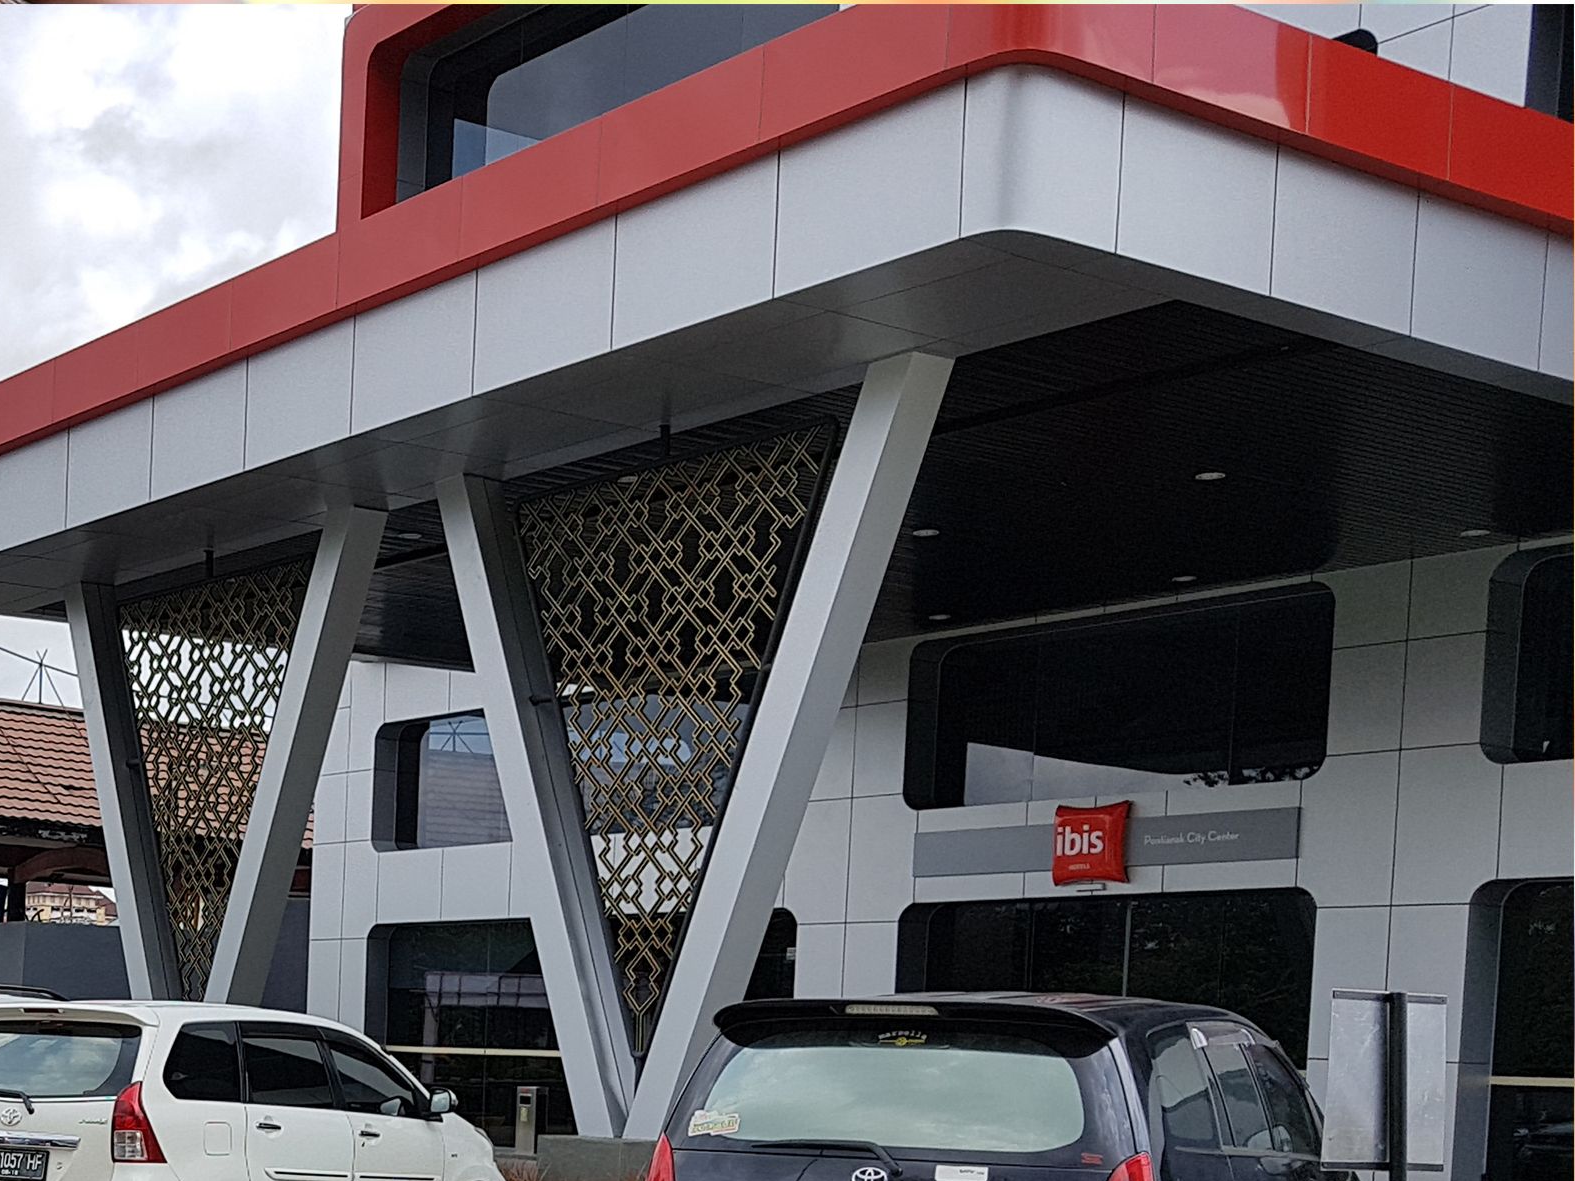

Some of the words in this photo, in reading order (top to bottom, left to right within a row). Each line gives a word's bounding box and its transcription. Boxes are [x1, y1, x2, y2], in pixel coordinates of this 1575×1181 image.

[1056, 824, 1104, 856] ibis
[1186, 831, 1206, 845] City
[1207, 830, 1240, 843] Center
[0, 1152, 24, 1169] 1057
[26, 1153, 43, 1170] HF
